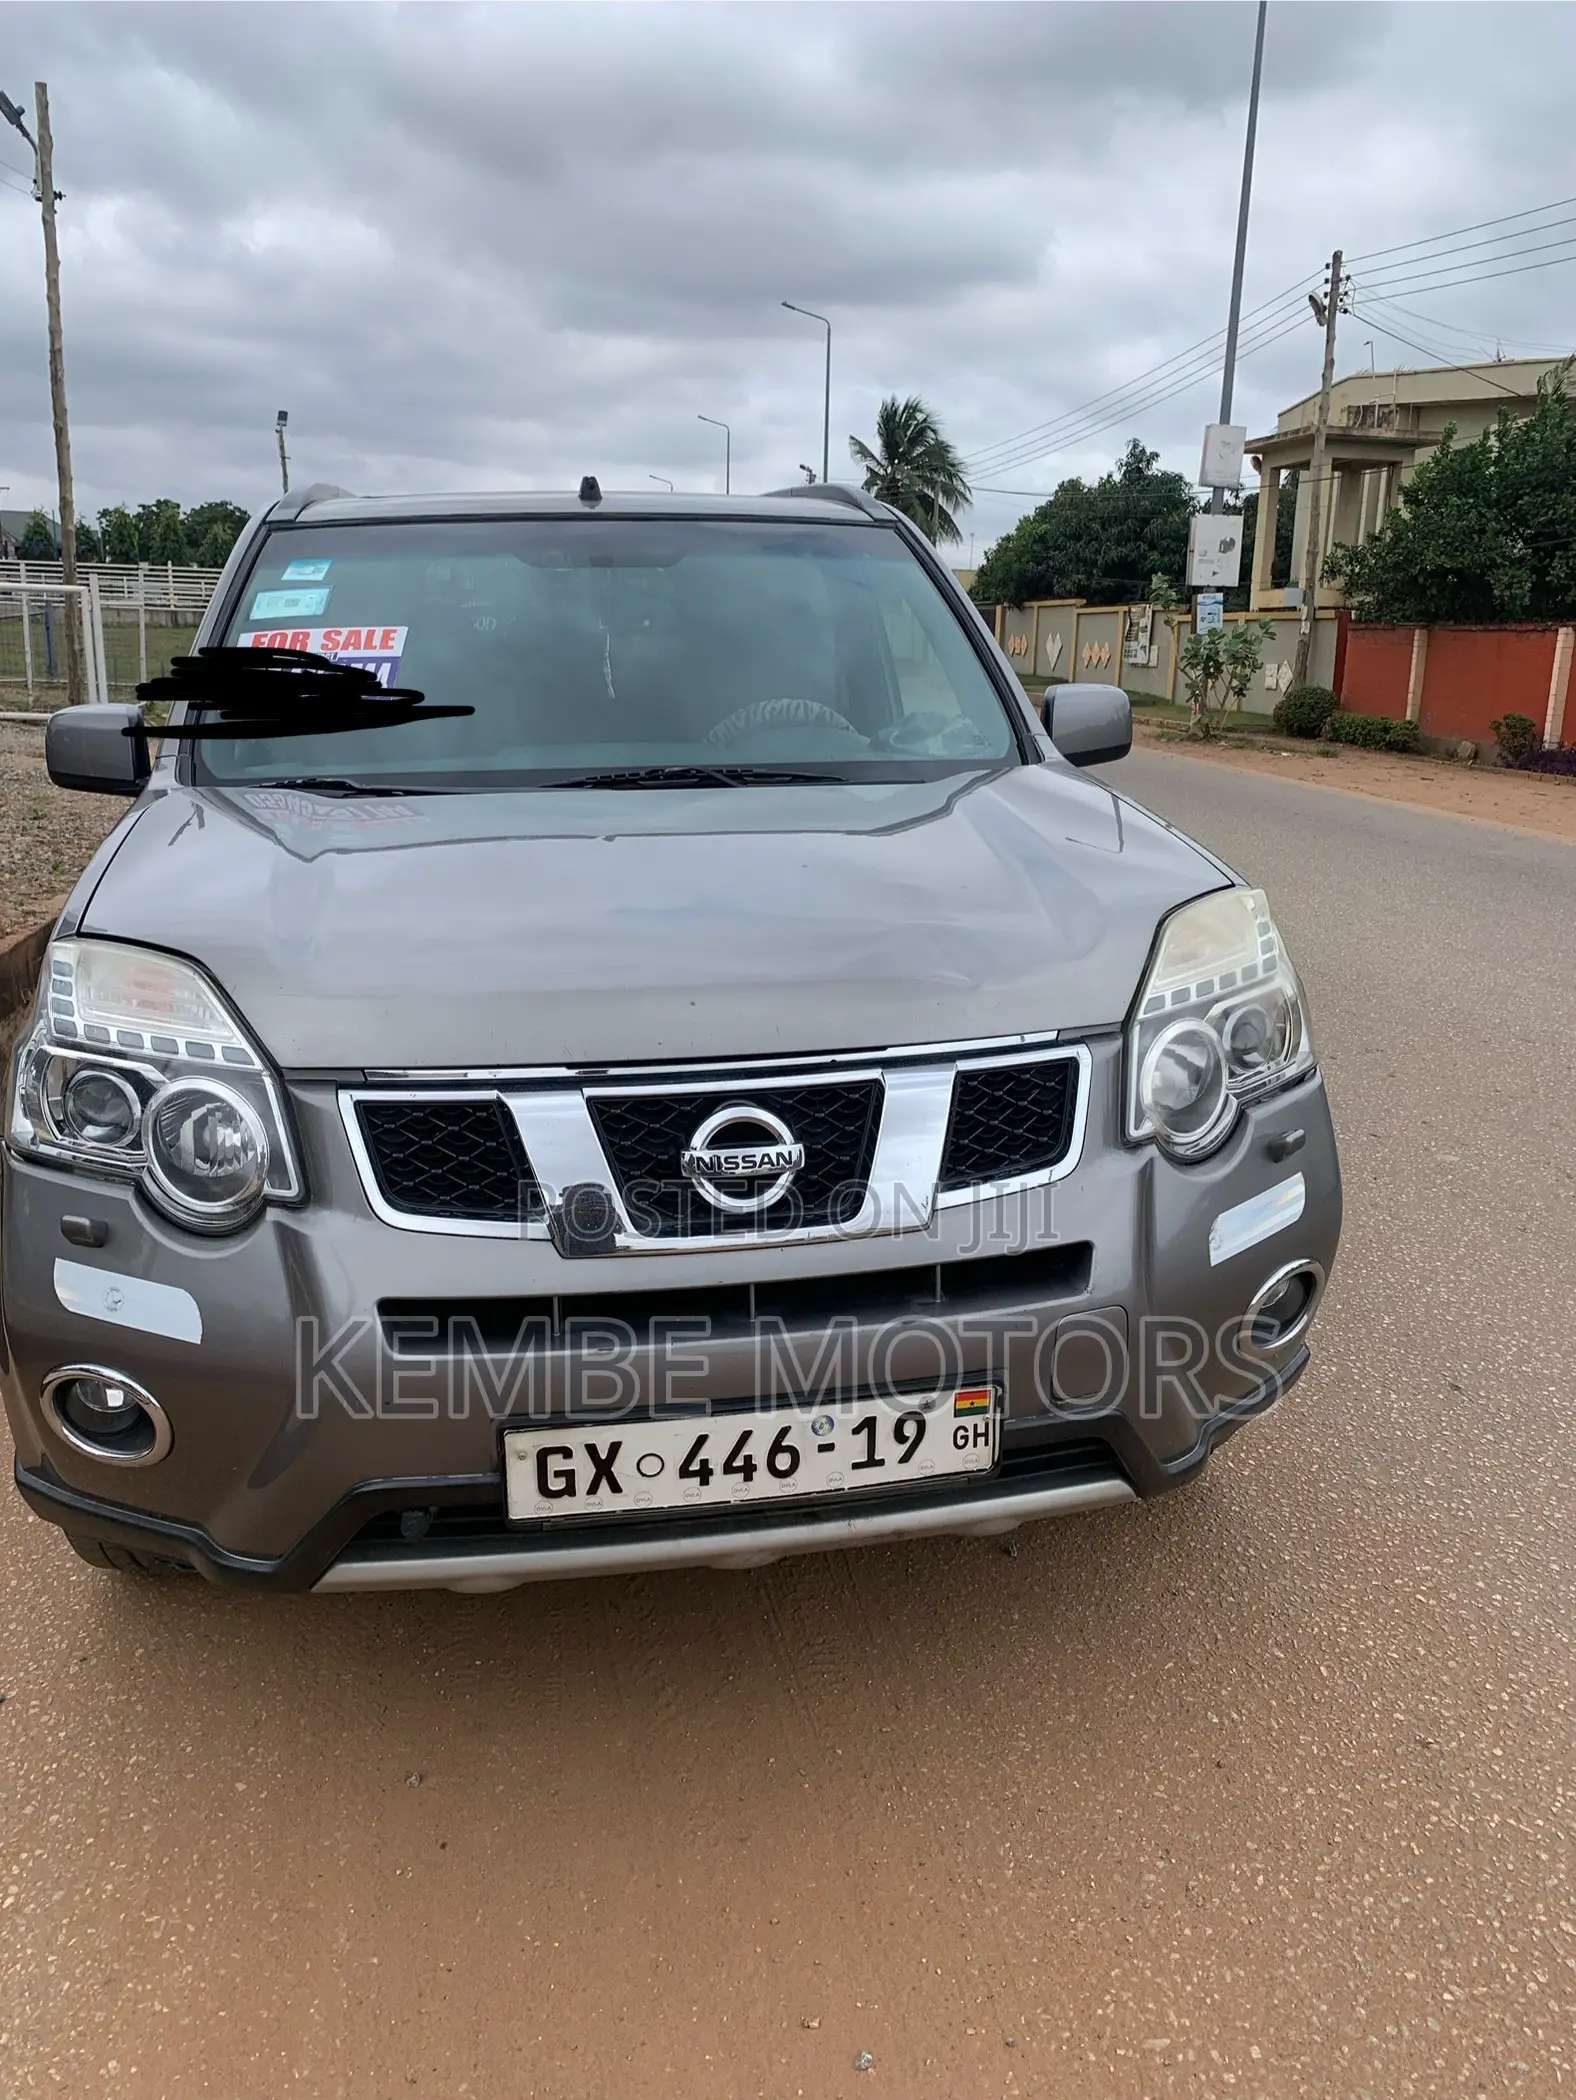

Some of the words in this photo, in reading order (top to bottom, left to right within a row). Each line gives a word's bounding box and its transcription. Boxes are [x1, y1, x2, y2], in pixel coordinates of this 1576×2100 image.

[252, 631, 311, 652] FOR
[320, 628, 398, 651] SALE
[695, 1150, 793, 1173] NISSAN
[952, 1421, 990, 1450] GH
[535, 1440, 623, 1499] GX
